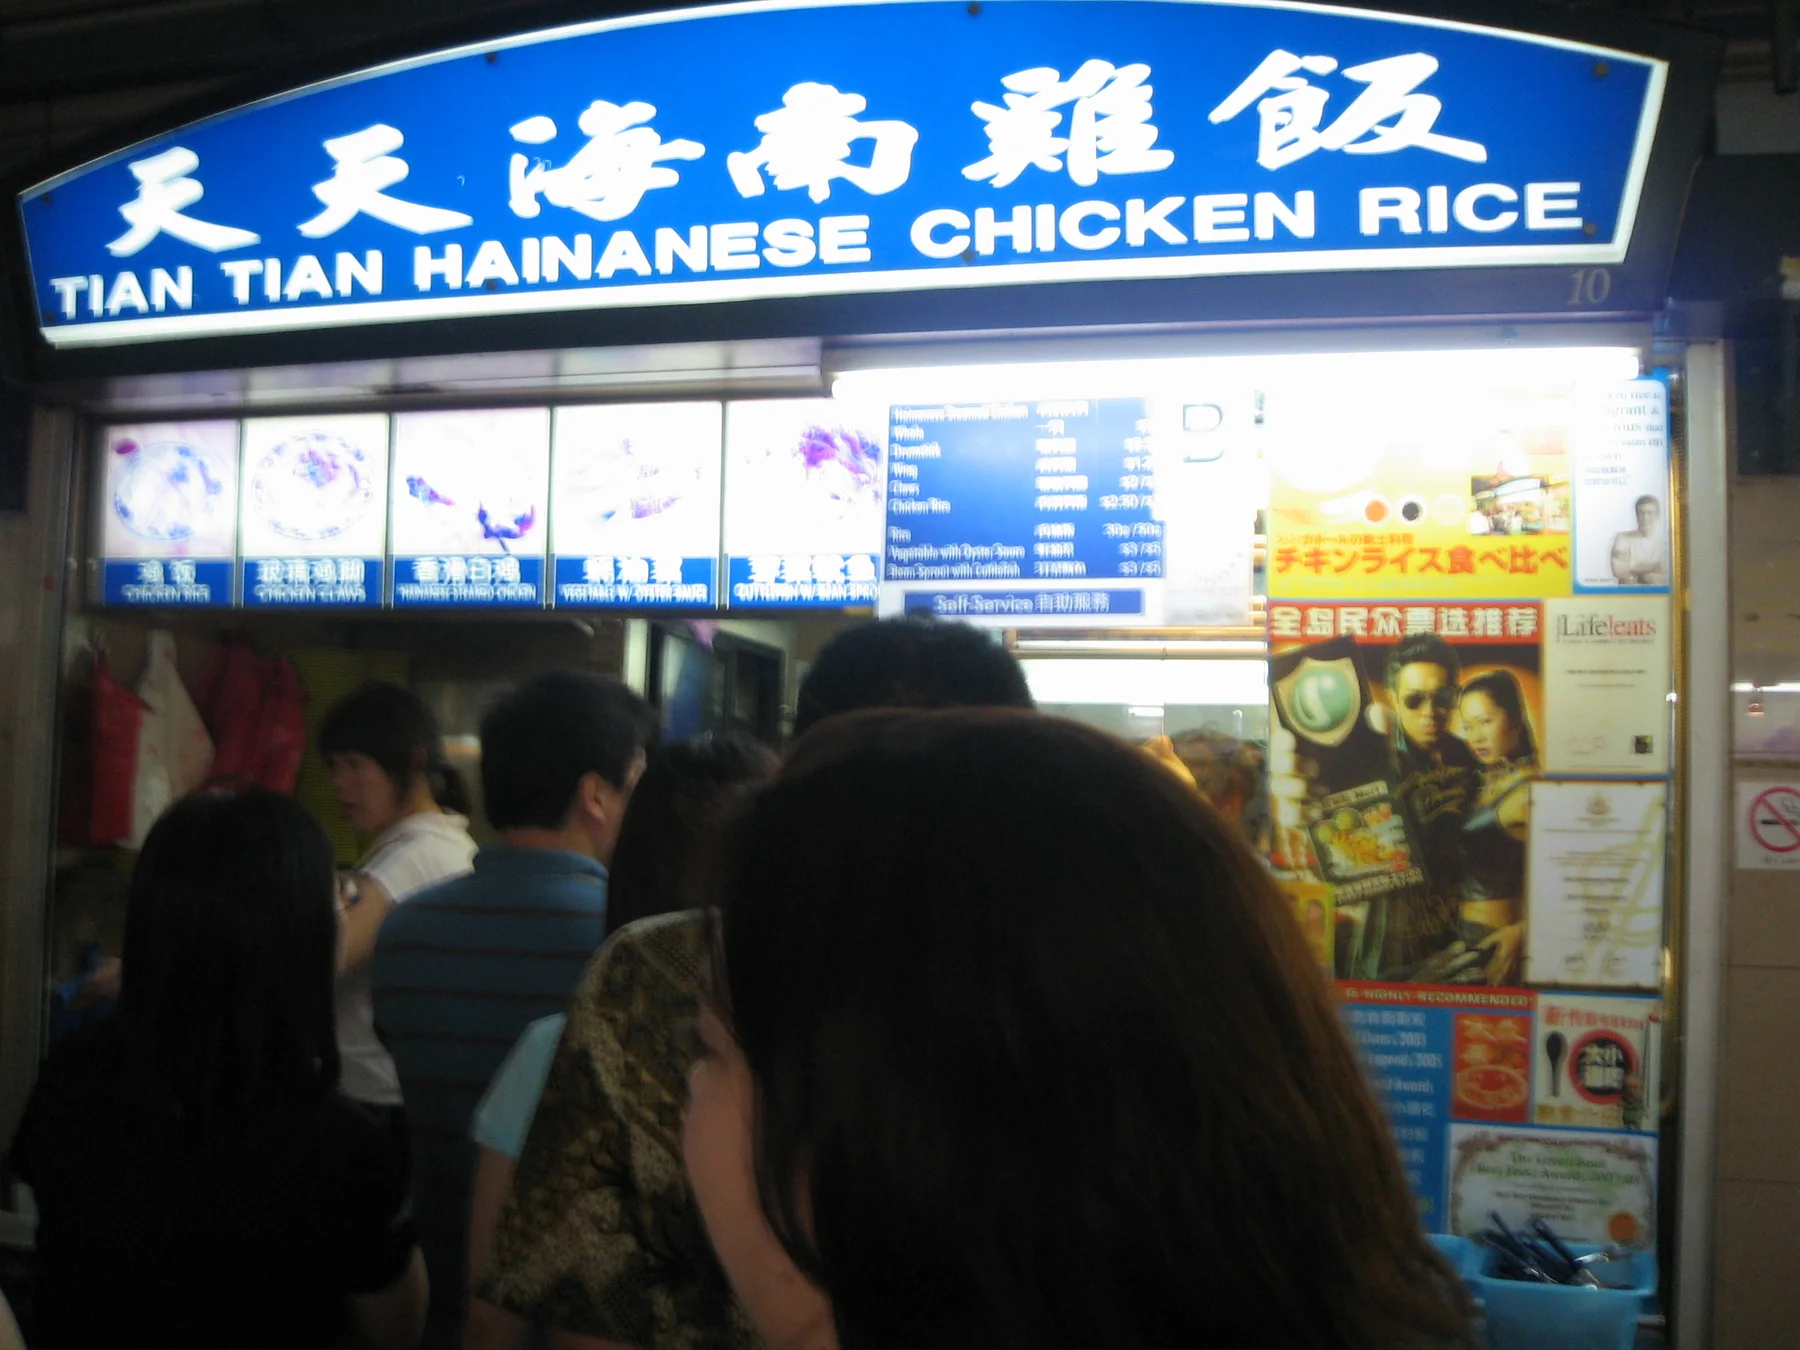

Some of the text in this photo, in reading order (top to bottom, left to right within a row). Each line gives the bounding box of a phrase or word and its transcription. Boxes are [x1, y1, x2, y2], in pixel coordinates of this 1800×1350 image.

[52, 181, 1584, 317] TIAN TIAN HAINANESE CHICKEN RICE
[1568, 267, 1611, 305] 10
[889, 461, 919, 480] Wing
[1275, 546, 1570, 575] チキンライス食べ比べ
[1271, 606, 1538, 637] 全岛民众票选推荐
